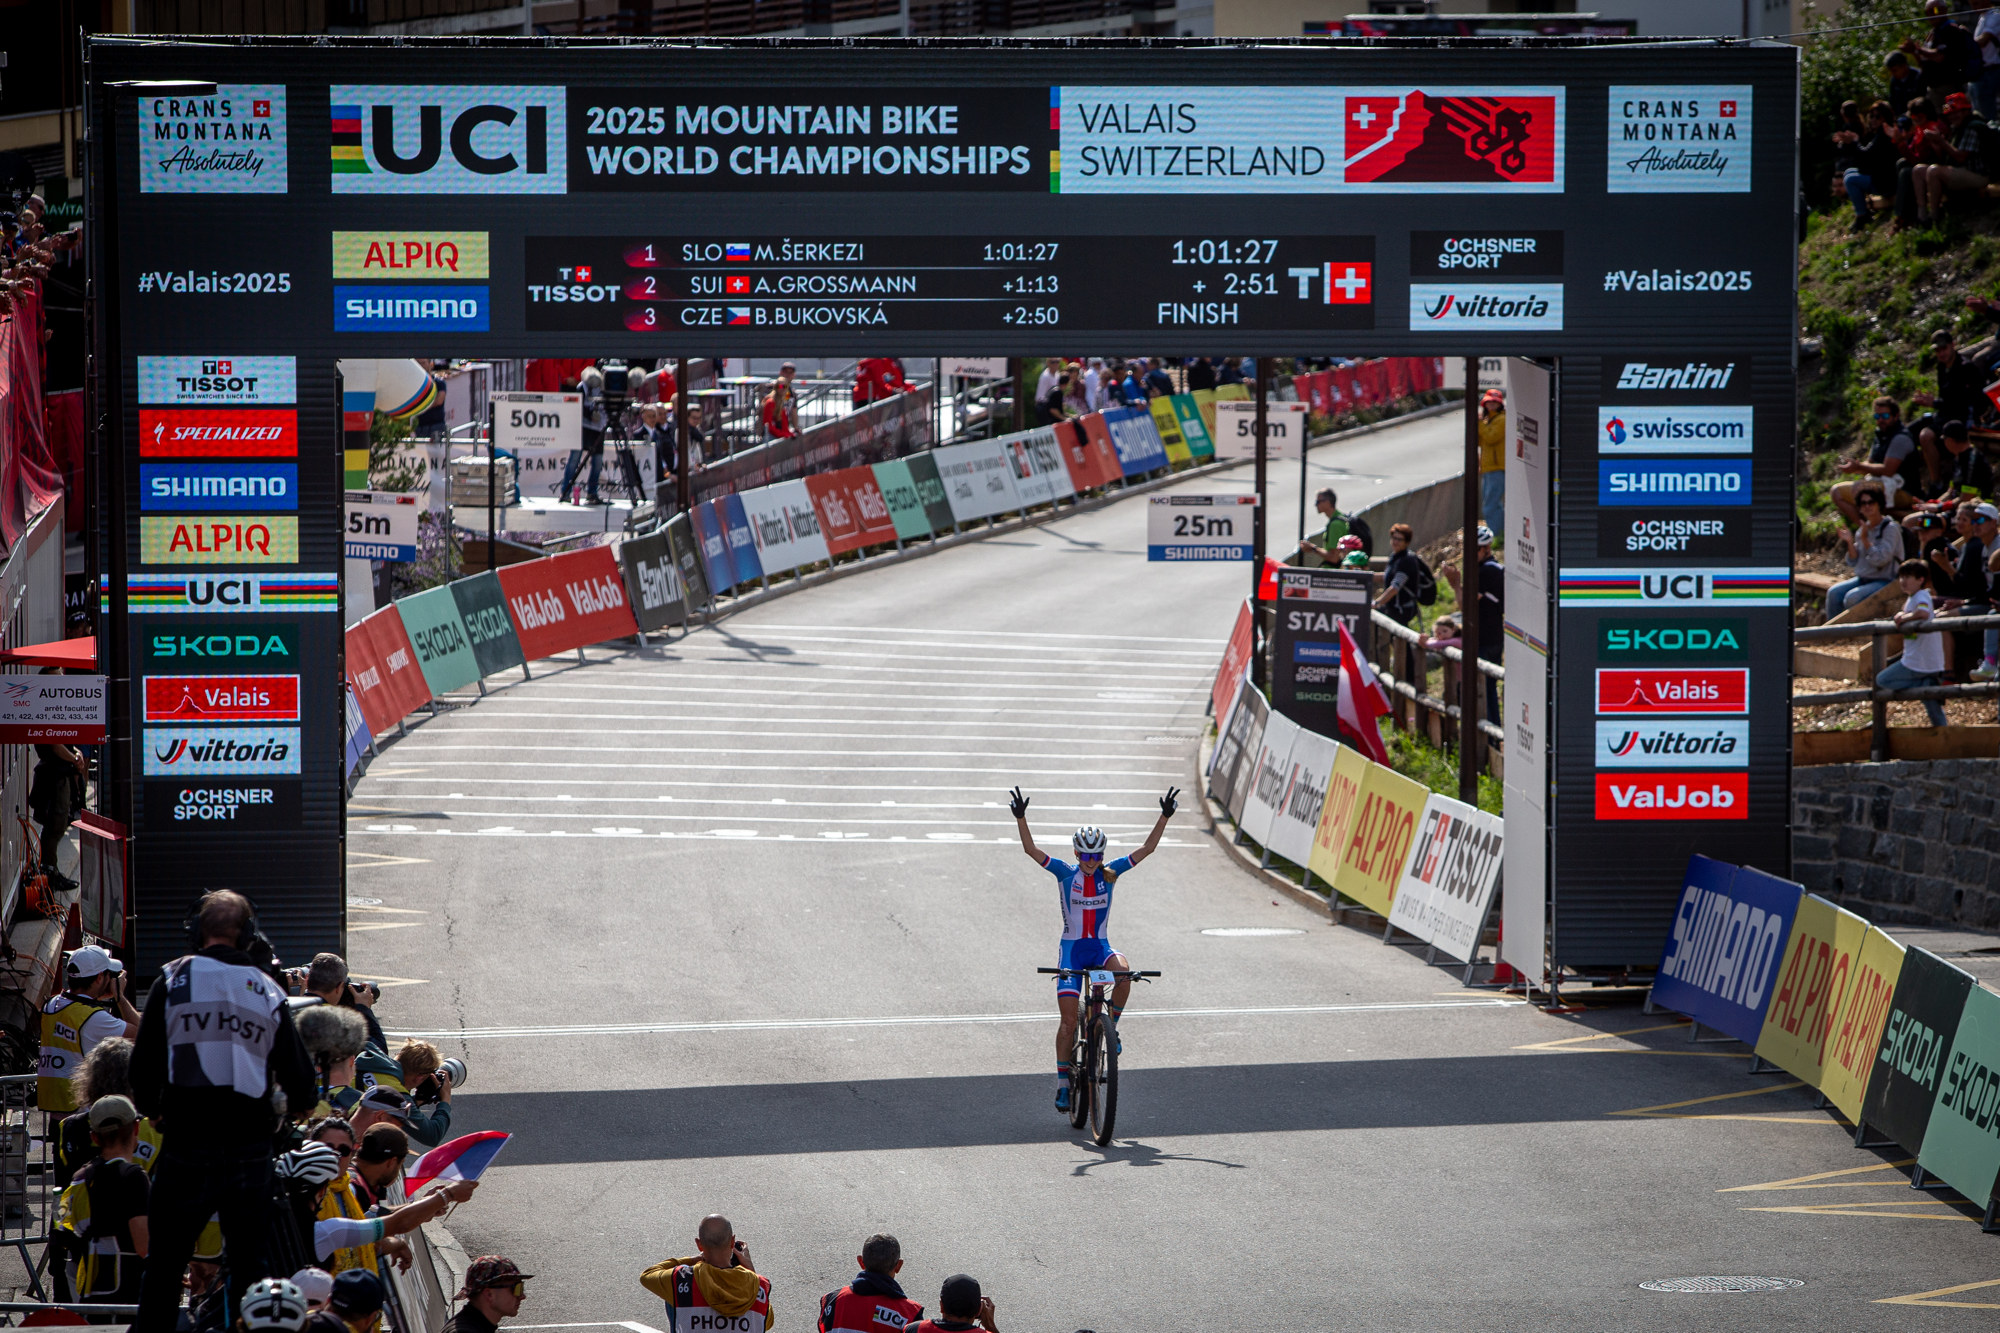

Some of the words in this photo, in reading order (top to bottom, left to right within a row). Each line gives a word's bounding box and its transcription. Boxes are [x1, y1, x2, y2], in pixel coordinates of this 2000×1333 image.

[153, 100, 232, 118] CRANS
[1078, 103, 1197, 134] VALAIS
[1623, 101, 1699, 118] CRANS
[586, 106, 665, 135] 2025
[676, 105, 871, 135] MOUNTAIN
[882, 106, 958, 135] BIKE
[154, 122, 272, 141] MONTANA
[372, 104, 548, 175] UCI
[1623, 123, 1737, 141] MONTANA
[159, 145, 264, 177] Absolutely
[586, 145, 719, 175] WORLD
[729, 145, 1031, 175] CHAMPIONSHIPS
[1079, 146, 1325, 176] SWITZERLAND
[1626, 146, 1729, 177] Absolutely
[644, 244, 656, 261] 1
[682, 244, 722, 261] SLO
[754, 238, 864, 261] M.ŠERKEZI
[983, 243, 1059, 261] 1:01:27
[1172, 239, 1279, 264] 1:01:27
[1444, 238, 1536, 253] OCHSNER
[363, 241, 459, 272] ALPIQ
[1438, 253, 1502, 268] SPORT
[138, 271, 291, 294] #Valais2025
[644, 276, 656, 294] 2
[691, 276, 722, 294] SUI
[754, 276, 916, 294] A.GROSSMANN
[1003, 276, 1059, 293] +1:13
[1224, 273, 1279, 295] 2:51
[1604, 270, 1752, 292] #Valais2025
[528, 285, 620, 302] TISSOT
[346, 299, 477, 319] SHIMANO
[644, 307, 656, 325] 3
[681, 307, 722, 325] CZE
[754, 301, 888, 325] B.BUKOVSKÁ
[1003, 307, 1059, 325] +2:50
[1158, 303, 1238, 324] FINISH
[1456, 294, 1549, 318] vittoria
[176, 378, 258, 392] TISSOT
[1616, 363, 1735, 389] Santini
[511, 409, 560, 428] 50m
[1633, 417, 1744, 438] swisscom
[170, 427, 282, 440] SPECIALIZED
[151, 477, 286, 496] SHIMANO
[1609, 473, 1741, 492] SHIMANO
[345, 512, 390, 535] 5m
[1174, 515, 1233, 536] 25m
[1632, 520, 1724, 535] OCHSNER
[169, 524, 270, 556] ALPIQ
[1626, 536, 1690, 550] SPORT
[345, 544, 399, 559] IMANO
[1165, 547, 1242, 559] SHIMANO
[637, 555, 682, 610] Santin
[1288, 576, 1308, 585] UCI
[1644, 575, 1704, 599] UCI
[189, 581, 251, 605] UCI
[512, 589, 565, 631] ValJob
[566, 575, 623, 616] ValJob
[1287, 611, 1359, 634] START
[39, 688, 102, 698] AUTOBUS
[204, 686, 270, 707] Valais
[1655, 679, 1719, 700] Valais
[28, 729, 43, 737] Lac
[46, 729, 78, 737] Grenon
[1640, 731, 1737, 754] vittoria
[189, 738, 288, 762] vittoria
[179, 789, 273, 804] OCHSNER
[1610, 785, 1735, 808] ValJob
[174, 805, 239, 820] SPORT
[1345, 792, 1414, 901] ALPIQ
[1436, 818, 1503, 907] TISSOT
[1098, 973, 1107, 981] 8
[1662, 885, 1782, 1011] SHIMANO
[1769, 932, 1849, 1067] ALPIQ
[1832, 963, 1893, 1103] ALPIQ
[56, 1024, 75, 1041] UCI
[181, 1012, 211, 1032] TV
[218, 1011, 266, 1044] HOST
[678, 1282, 689, 1293] 66
[691, 1315, 750, 1332] PHOTO
[880, 1308, 905, 1328] UCI
